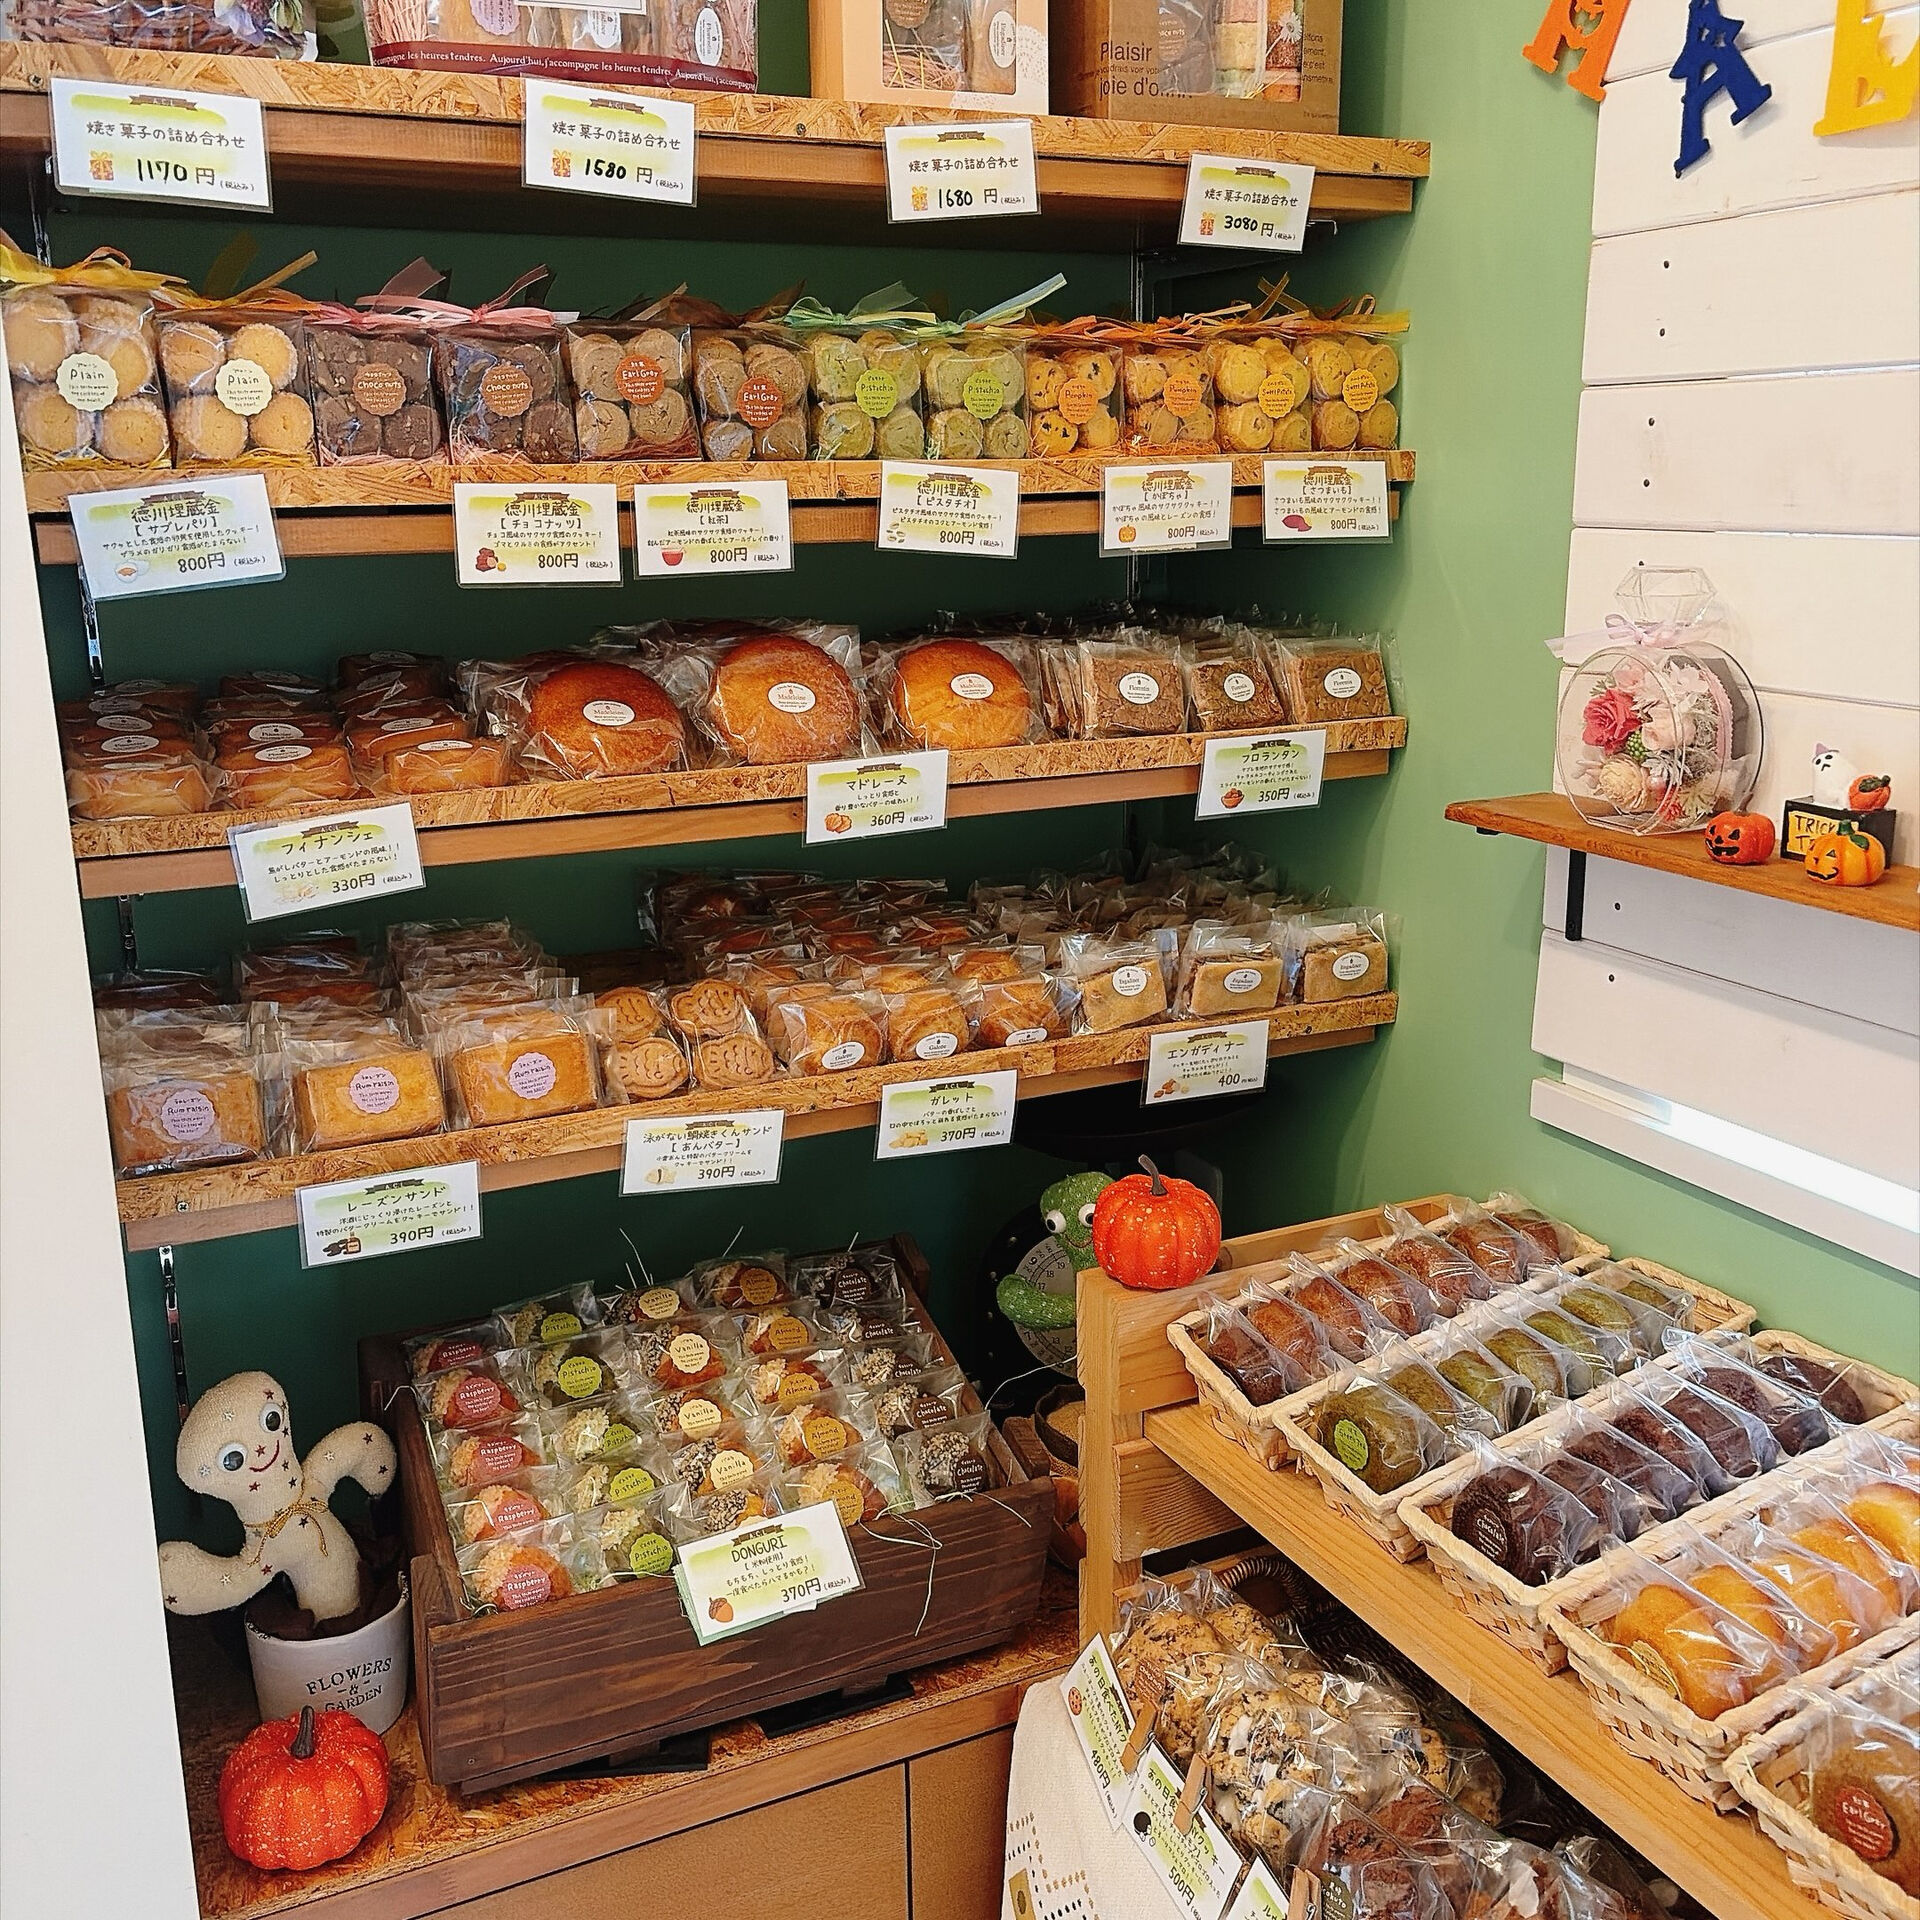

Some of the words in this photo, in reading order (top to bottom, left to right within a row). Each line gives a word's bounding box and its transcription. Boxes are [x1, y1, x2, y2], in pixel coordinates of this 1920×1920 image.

[1101, 41, 1152, 61] Plaisir
[407, 51, 419, 60] les
[420, 50, 449, 61] heures
[450, 52, 486, 63] tendres.
[601, 62, 613, 72] les
[614, 65, 641, 73] heures
[642, 65, 673, 77] tendres.
[1100, 76, 1127, 101] joie
[86, 120, 246, 148] 焼き菓子の詰め合わせ
[552, 121, 681, 151] 焼き菓子の詰め合わせ
[136, 158, 188, 183] 1170
[195, 167, 216, 185] 円
[585, 158, 627, 180] 1580
[636, 166, 652, 184] 円
[909, 156, 1019, 173] 焼き菓子の詰め合わせ
[938, 188, 973, 209] 1680
[984, 188, 998, 204] 円
[1204, 189, 1299, 207] 焼き菓子の詰め合わせ
[1224, 215, 1258, 232] 3080
[1260, 223, 1275, 237] 円
[70, 368, 104, 381] Plain
[228, 373, 259, 385] Plain
[622, 369, 640, 379] Earl
[640, 369, 659, 380] Grey
[358, 380, 385, 389] Choco
[386, 380, 402, 389] nuts
[486, 384, 511, 393] Choco
[511, 382, 529, 391] nuts
[861, 383, 894, 393] Pistachio
[968, 385, 1000, 395] Pistachio
[743, 393, 761, 403] Earl
[761, 394, 779, 404] Grey
[917, 481, 983, 499] 徳川埋蔵金
[131, 498, 221, 523] 徳川埋蔵金
[504, 500, 582, 517] 徳川埋蔵金
[686, 499, 746, 514] 徳川埋蔵金
[1330, 518, 1357, 530] 800円
[939, 530, 975, 545] 800円
[1167, 526, 1196, 539] 800円
[177, 552, 226, 574] 800円
[538, 553, 578, 569] 800円
[710, 547, 748, 563] 800円
[1242, 749, 1300, 764] フロランタン
[846, 774, 908, 791] マドレーヌ
[1258, 787, 1290, 802] 350円
[871, 811, 905, 827] 360円
[281, 829, 374, 855] フィナンシェ
[332, 873, 375, 893] 330円
[1167, 1041, 1245, 1060] エンガディナー
[514, 1070, 530, 1080] Rum
[530, 1064, 551, 1075] raisin
[1218, 1073, 1240, 1087] 400
[355, 1083, 373, 1091] Rum
[373, 1080, 395, 1089] raisin
[930, 1092, 974, 1106] ガレット
[167, 1107, 186, 1116] Rum
[186, 1105, 210, 1114] raisin
[940, 1127, 976, 1142] 370円
[697, 1165, 736, 1180] 390円
[347, 1186, 447, 1213] レーズンサンド
[390, 1226, 434, 1245] 390円
[838, 1276, 867, 1288] Chocolate
[865, 1327, 893, 1339] Chocolate
[674, 1344, 703, 1354] Vanilla
[562, 1366, 596, 1378] Pistachio
[460, 1386, 494, 1400] Raspberry
[785, 1385, 813, 1396] Almond
[684, 1408, 713, 1420] Vanilla
[915, 1405, 946, 1418] Chocolate
[811, 1427, 839, 1439] Almond
[481, 1444, 516, 1456] Raspberry
[716, 1461, 746, 1475] Vanilla
[956, 1464, 983, 1477] Chocolate
[614, 1476, 648, 1497] Pistachio
[497, 1508, 535, 1524] Raspberry
[634, 1545, 669, 1561] Pistachio
[731, 1535, 788, 1563] DONGURI
[507, 1576, 547, 1592] Raspberry
[781, 1577, 821, 1604] 370円
[306, 1657, 392, 1695] FLOWERS
[325, 1685, 382, 1712] GARDEN
[1091, 1749, 1111, 1789] 480円
[1168, 1866, 1195, 1906] 500円
